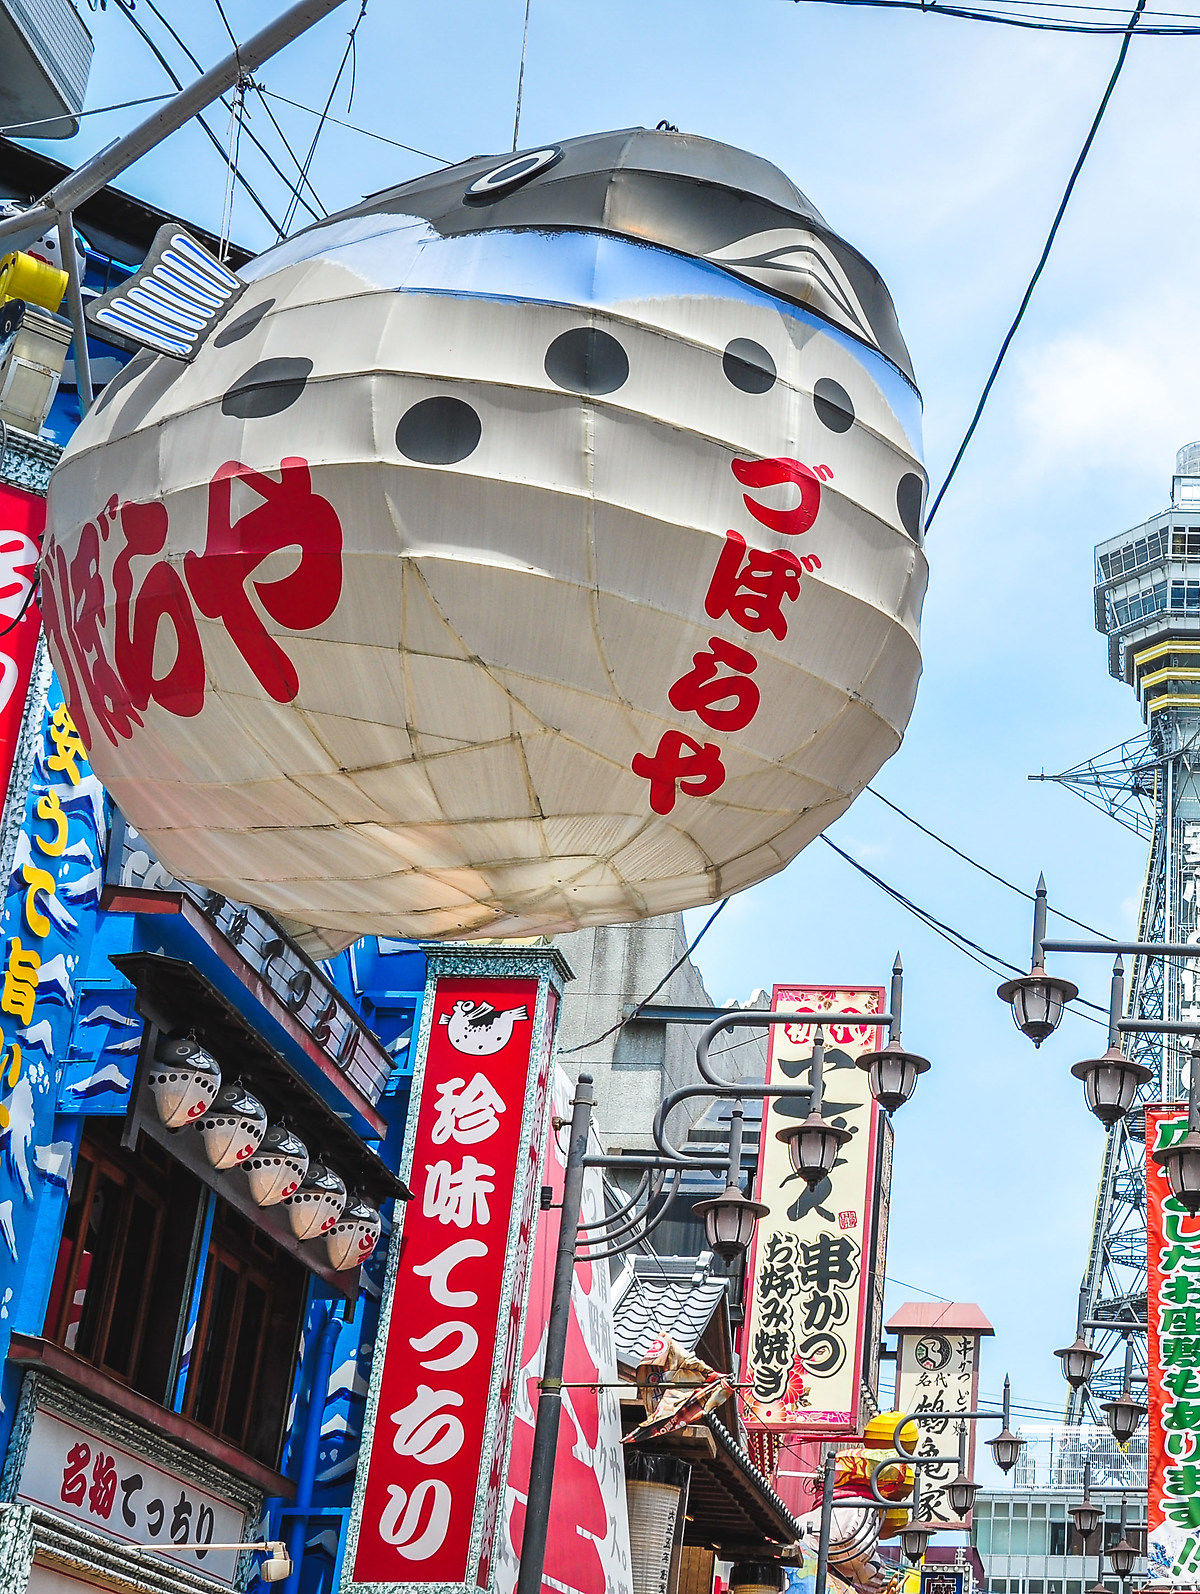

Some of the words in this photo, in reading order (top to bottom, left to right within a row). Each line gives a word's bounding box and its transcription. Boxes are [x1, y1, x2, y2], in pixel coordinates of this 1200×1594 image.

[631, 457, 834, 815] づぼらや
[772, 1048, 864, 1222] エス
[379, 1072, 507, 1562] 珍味てっちり
[753, 1233, 795, 1397] お好み焼き
[799, 1233, 855, 1372] 串かつ
[61, 1442, 214, 1560] 名物てっちり
